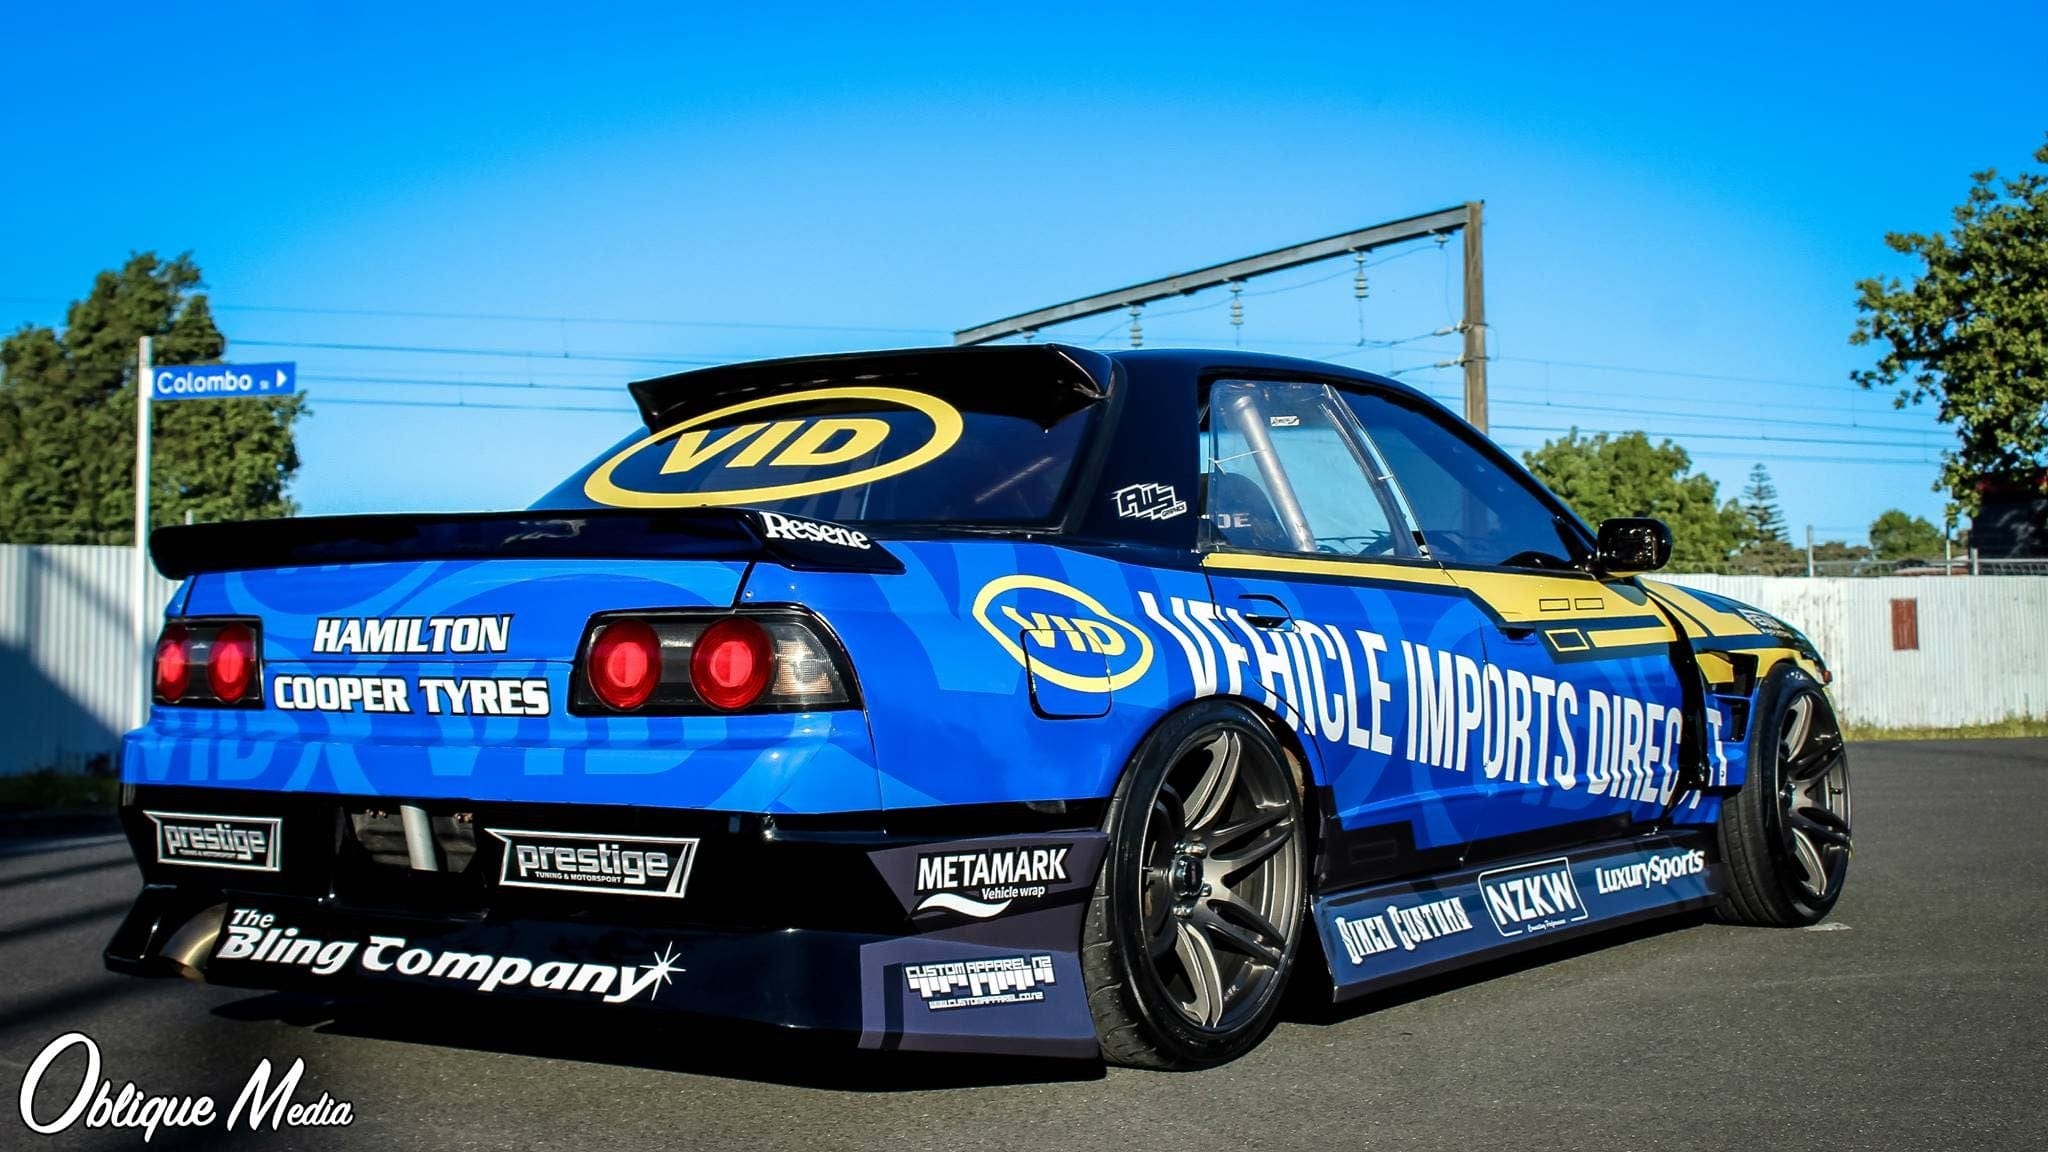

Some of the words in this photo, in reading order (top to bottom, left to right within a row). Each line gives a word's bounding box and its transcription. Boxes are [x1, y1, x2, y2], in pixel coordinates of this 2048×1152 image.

[157, 370, 252, 394] Colombo
[659, 418, 891, 475] VID
[758, 511, 872, 550] Resene
[312, 615, 512, 653] HAMILTON
[1000, 605, 1127, 656] VID
[274, 676, 411, 713] COOPER
[419, 678, 551, 715] TYRES
[1138, 592, 1394, 756] VEHICLE
[1400, 640, 1577, 791] IMPORTS
[1587, 689, 1728, 809] DIRECT
[163, 823, 267, 861] prestige
[516, 843, 669, 885] prestige
[535, 870, 564, 880] TUNING
[564, 873, 570, 881] &
[570, 873, 622, 884] MOTORSPORT
[917, 848, 1068, 891] METAMARK
[1595, 848, 1705, 895] LuxurySports
[981, 887, 1019, 901] Vehicle
[1019, 885, 1046, 898] wrap
[1485, 870, 1577, 926] NZKW
[232, 909, 275, 929] The
[216, 926, 359, 975] Bling
[362, 935, 658, 1003] Company
[904, 962, 967, 979] CUSTOM
